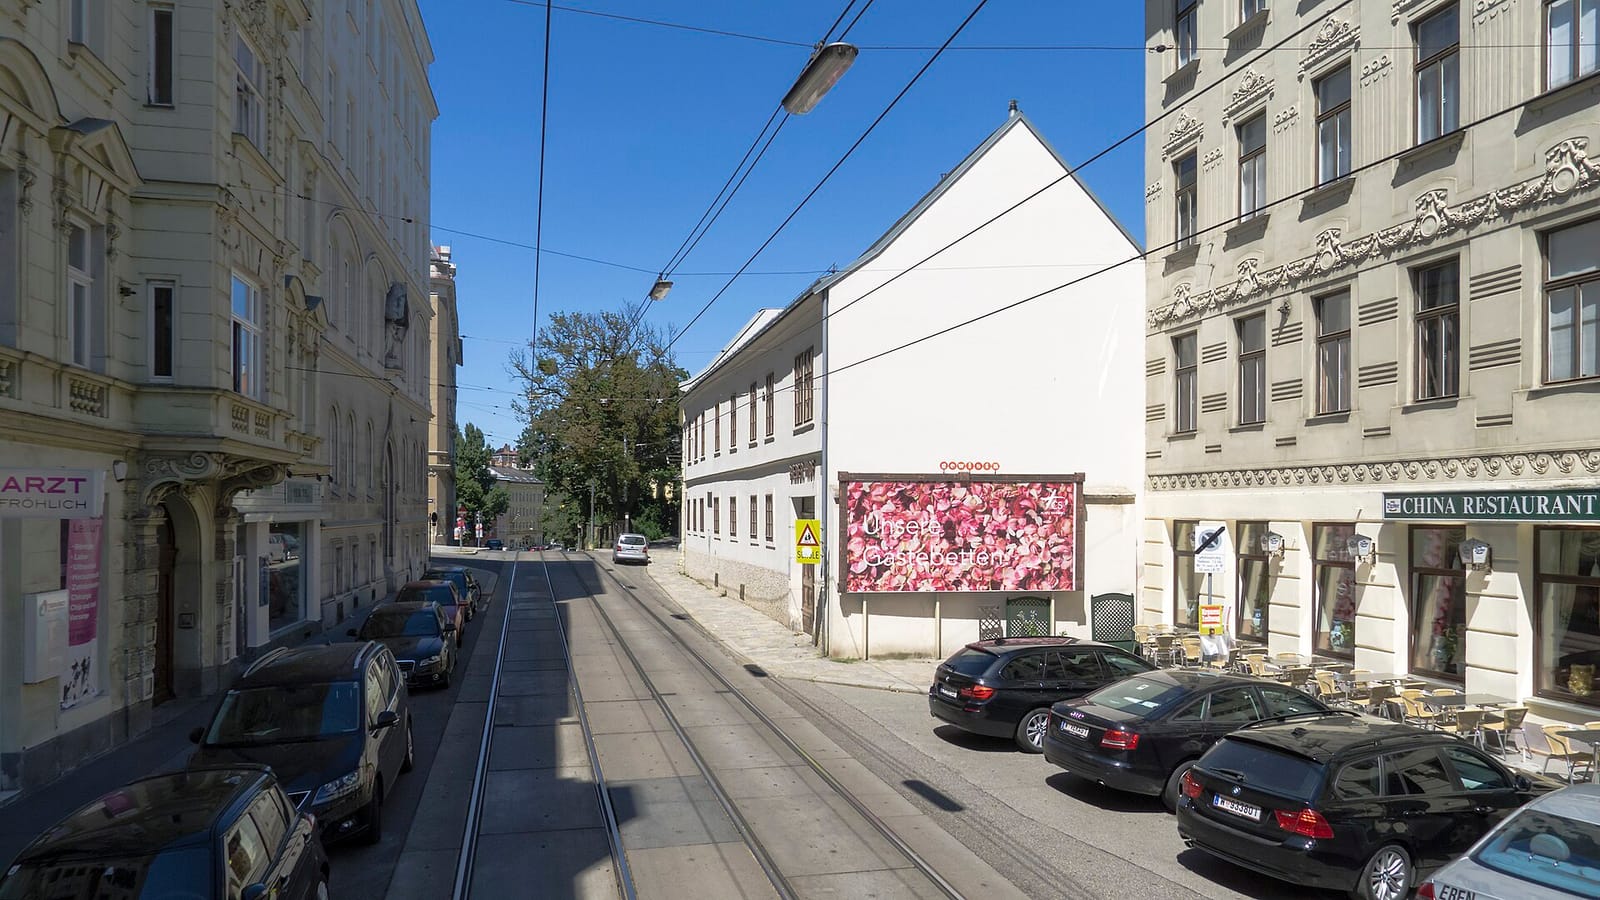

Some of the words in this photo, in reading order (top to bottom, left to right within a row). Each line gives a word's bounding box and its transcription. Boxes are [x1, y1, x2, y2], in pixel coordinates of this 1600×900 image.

[1, 476, 87, 494] ARZT
[1402, 496, 1456, 514] CHINA
[1463, 494, 1597, 514] RESTAURANT
[863, 514, 941, 535] Unsere
